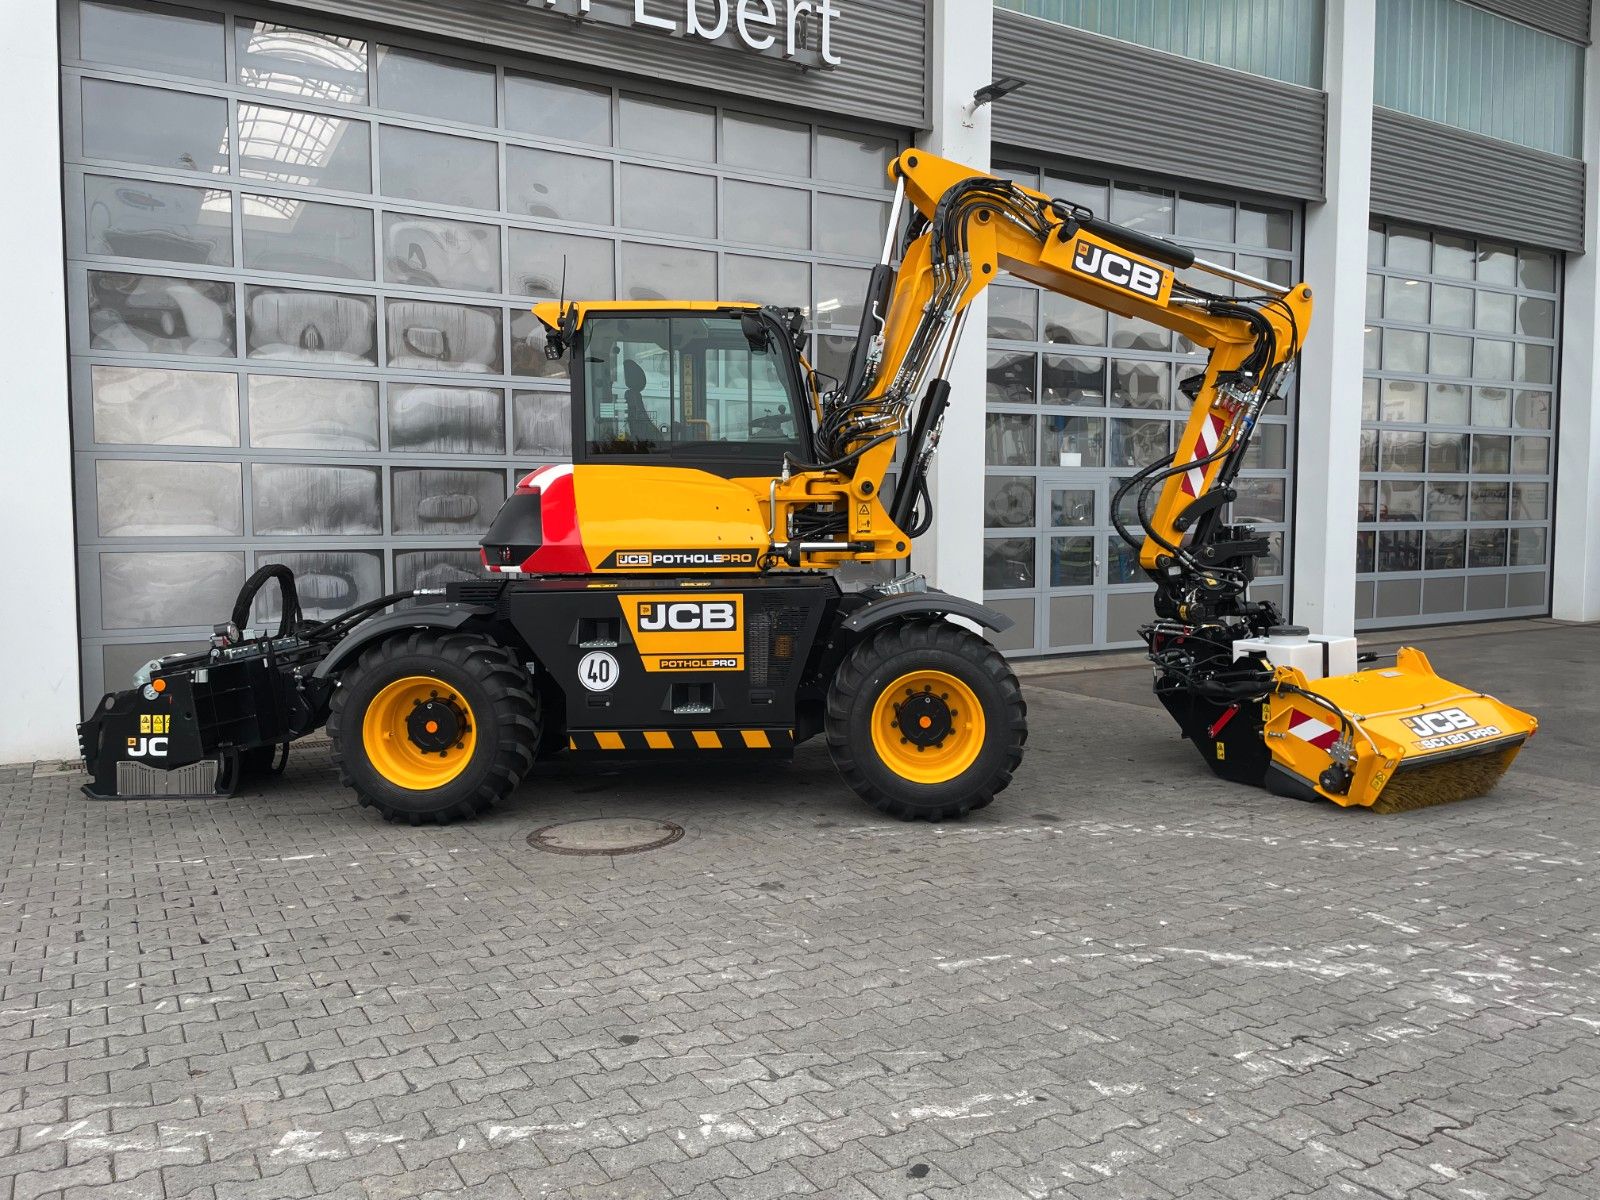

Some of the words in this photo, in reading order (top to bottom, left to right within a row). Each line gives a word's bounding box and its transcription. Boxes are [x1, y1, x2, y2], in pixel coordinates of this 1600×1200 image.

[1075, 247, 1160, 296] JCB
[619, 554, 649, 564] JCB
[640, 603, 735, 630] JCB
[587, 659, 610, 683] 40
[1411, 708, 1477, 737] JCB
[1466, 726, 1502, 739] PRO
